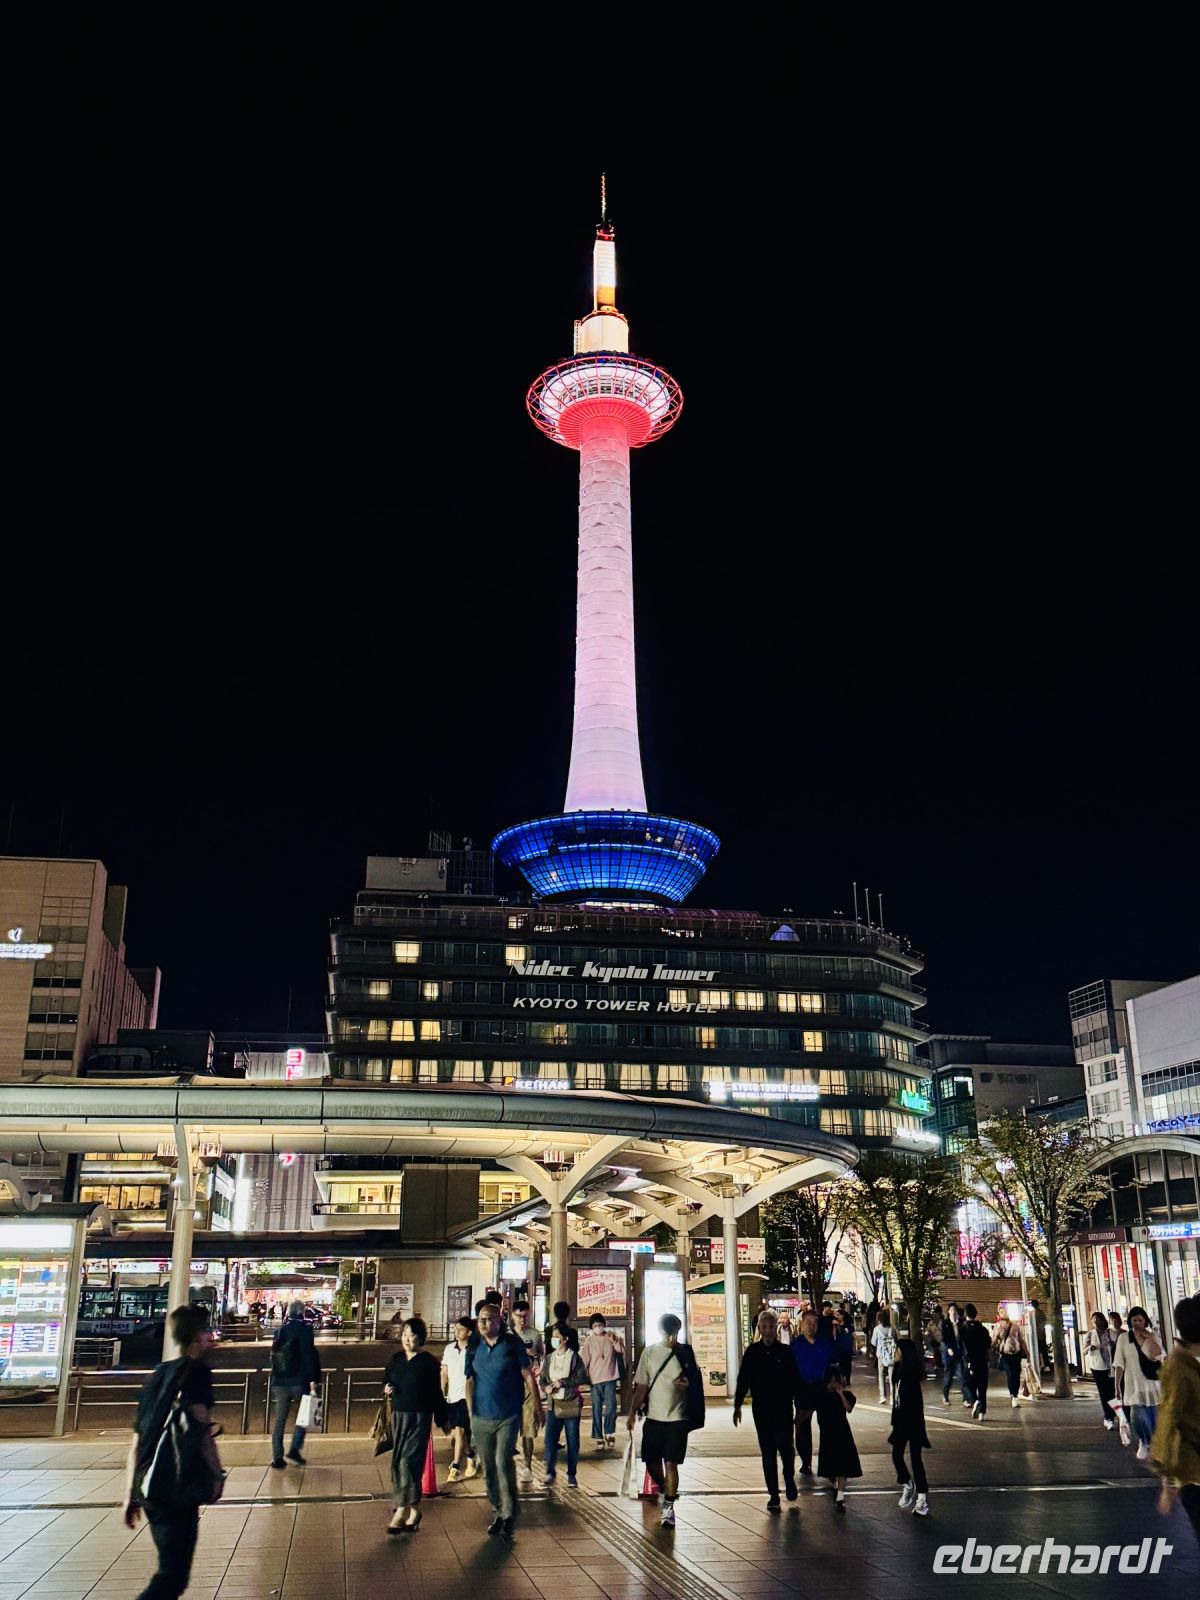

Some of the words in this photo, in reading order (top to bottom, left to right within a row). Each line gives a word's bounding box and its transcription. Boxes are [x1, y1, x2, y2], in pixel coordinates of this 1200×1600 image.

[510, 960, 576, 977] Nidec
[582, 961, 649, 983] Kyoto
[652, 963, 721, 981] Tower
[513, 997, 578, 1009] KYOTO
[585, 999, 650, 1011] TOWER
[656, 1001, 718, 1014] HOTEL
[515, 1080, 569, 1090] KEIHAN
[697, 1250, 707, 1258] D1
